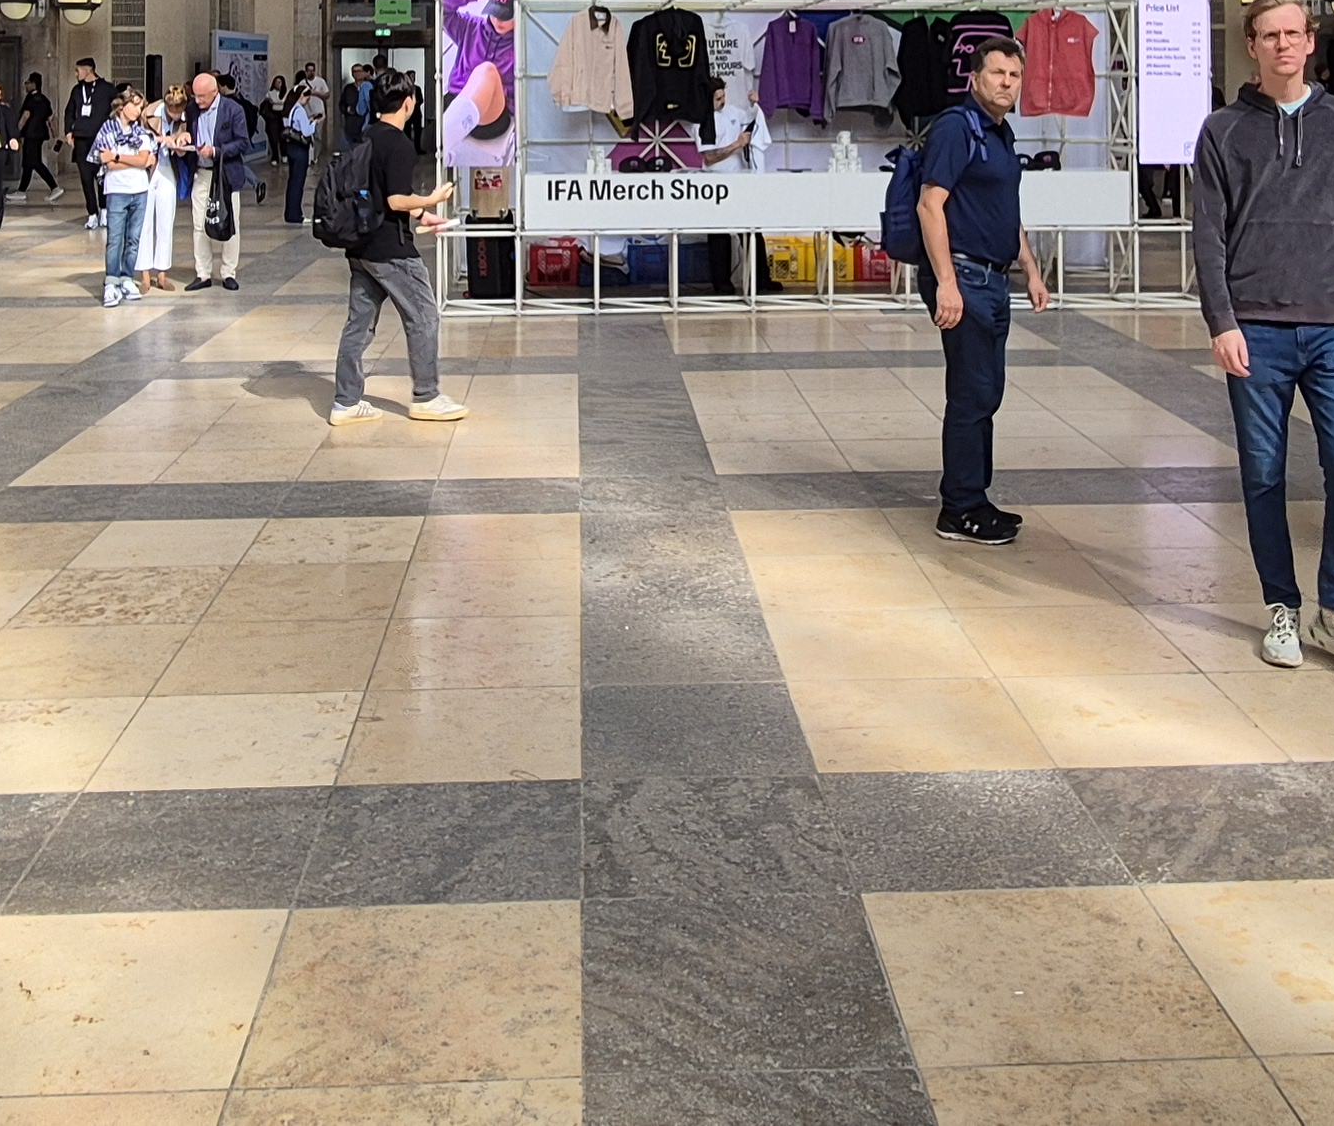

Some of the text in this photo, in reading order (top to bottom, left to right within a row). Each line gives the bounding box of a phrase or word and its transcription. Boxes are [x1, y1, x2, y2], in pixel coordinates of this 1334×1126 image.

[1146, 4, 1180, 12] Price List
[709, 39, 738, 48] UTURE
[547, 179, 729, 205] IFA Merch Shop
